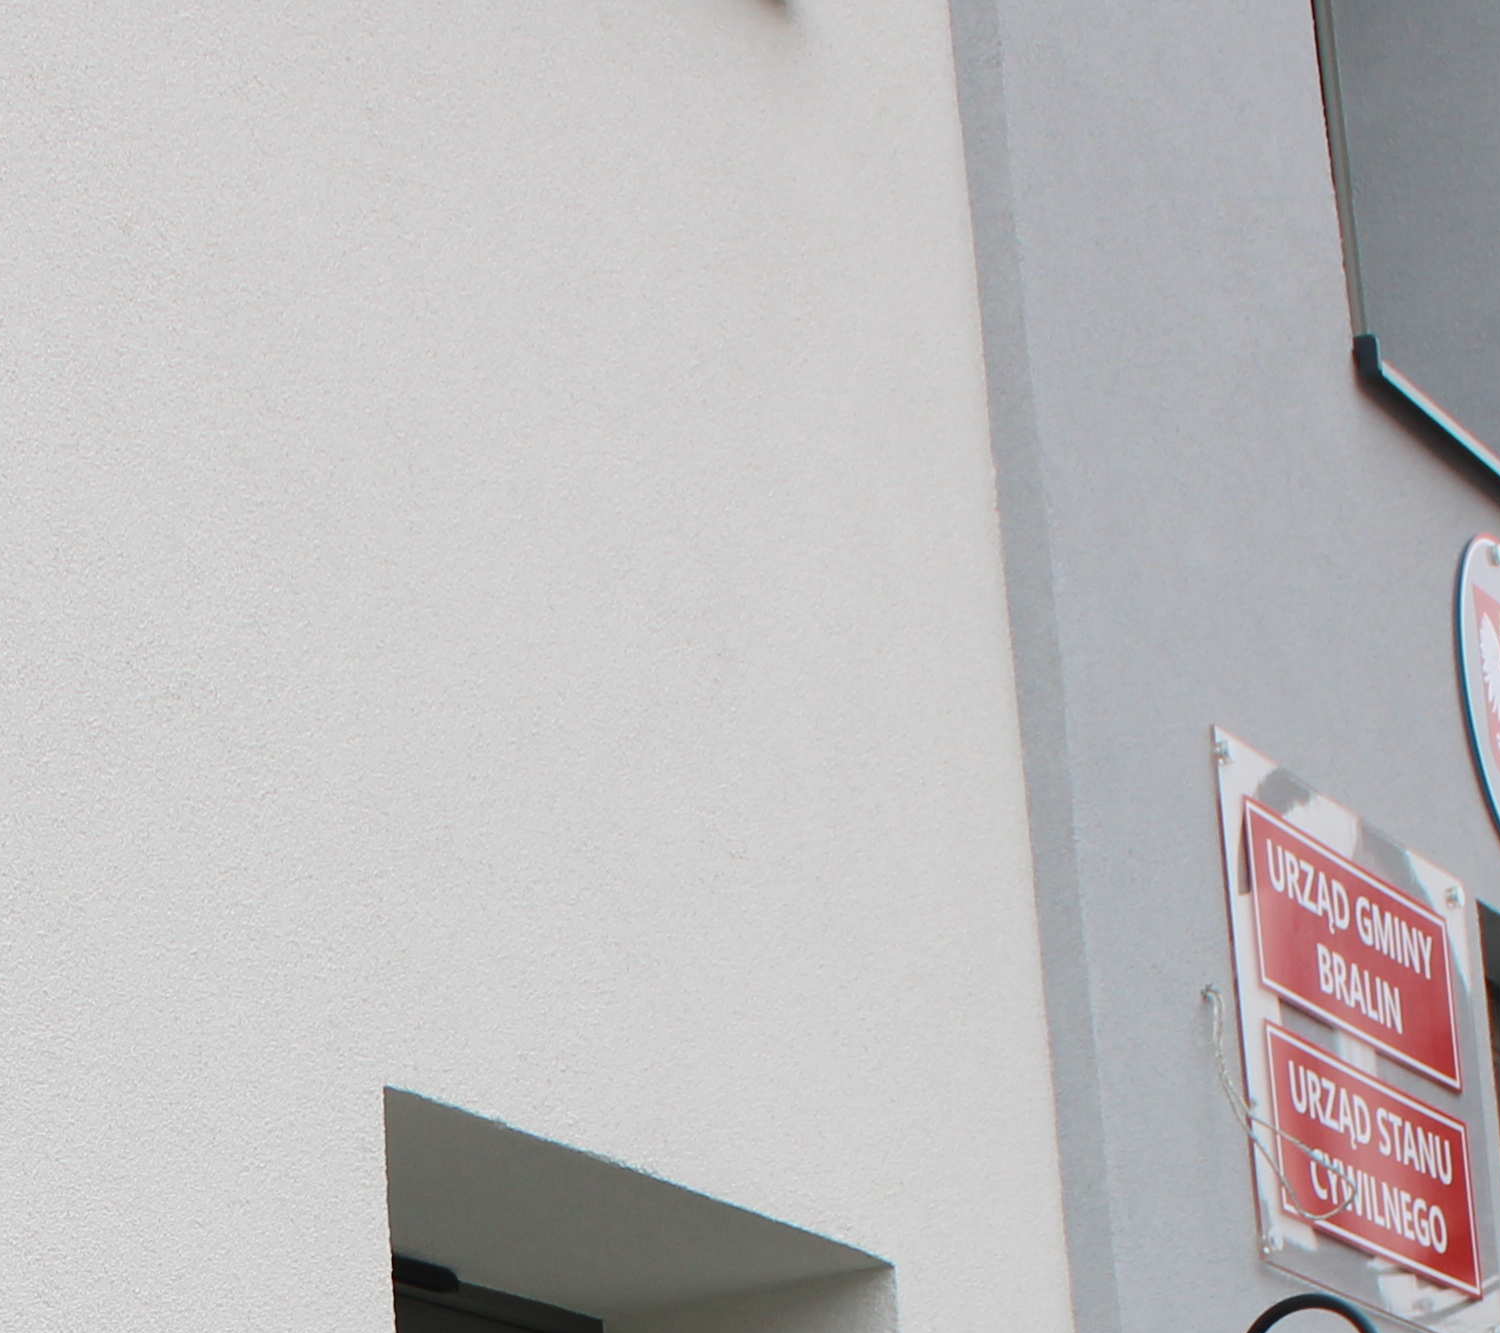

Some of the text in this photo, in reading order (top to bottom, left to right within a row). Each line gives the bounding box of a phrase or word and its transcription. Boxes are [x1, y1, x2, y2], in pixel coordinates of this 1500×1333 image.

[1266, 838, 1432, 980] URZĄD GMINY
[1316, 942, 1403, 1034] BRALIN
[1288, 1060, 1452, 1185] URZĄD STANU
[1310, 1148, 1448, 1254] CYWILNEGO
